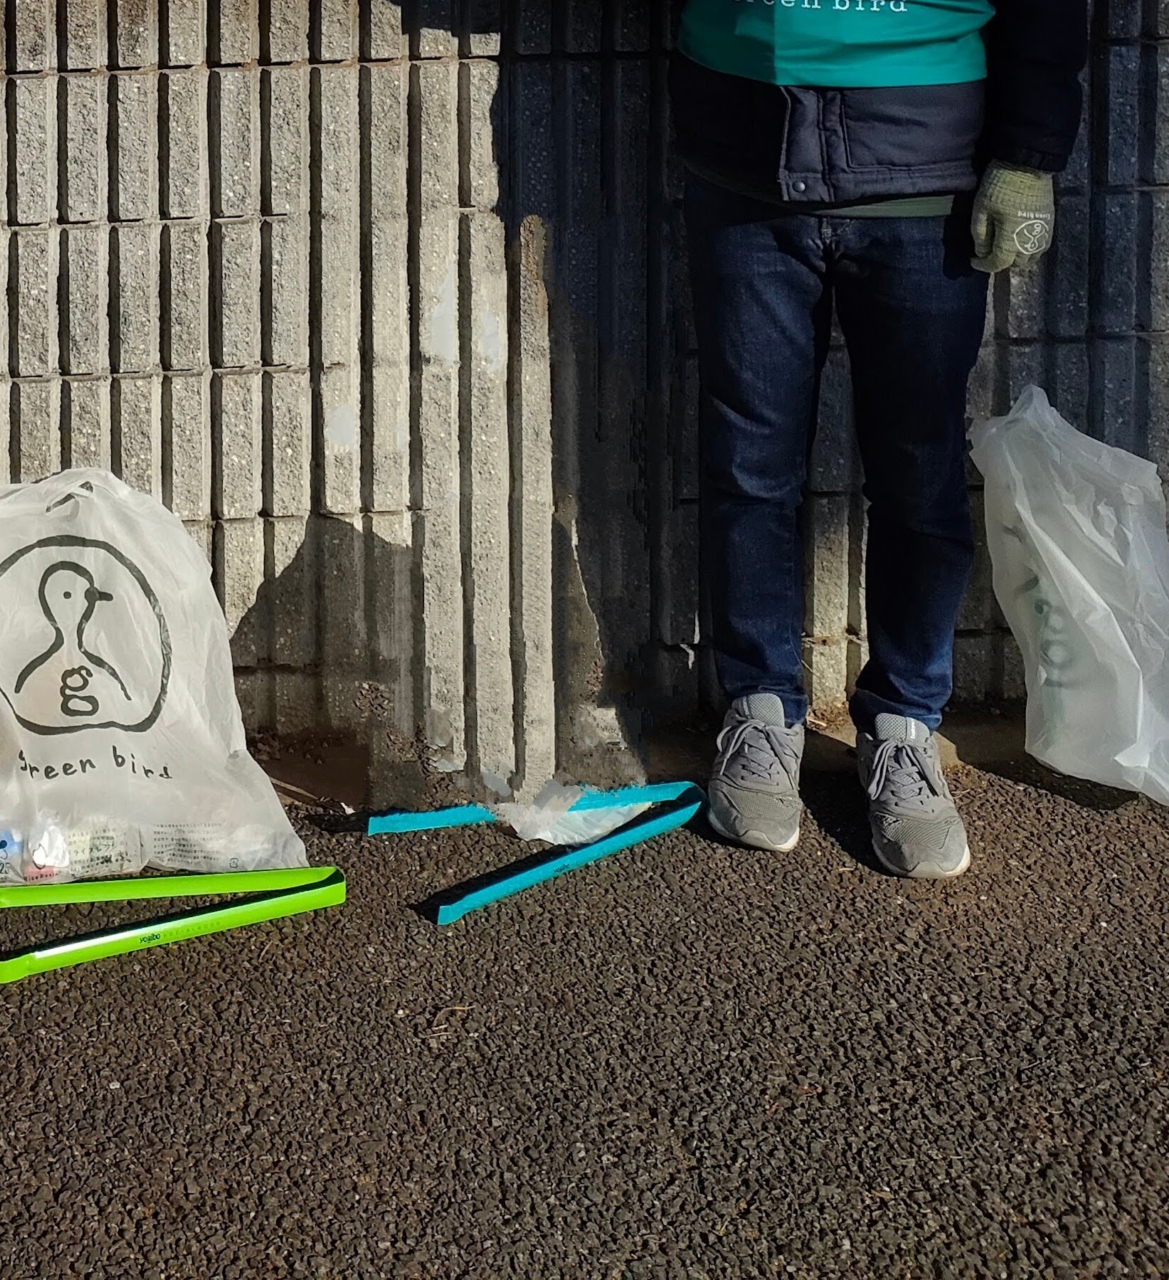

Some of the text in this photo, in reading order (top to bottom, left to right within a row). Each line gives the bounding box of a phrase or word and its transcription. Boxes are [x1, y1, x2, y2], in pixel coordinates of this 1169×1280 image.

[59, 665, 99, 717] g
[18, 744, 173, 780] green bird
